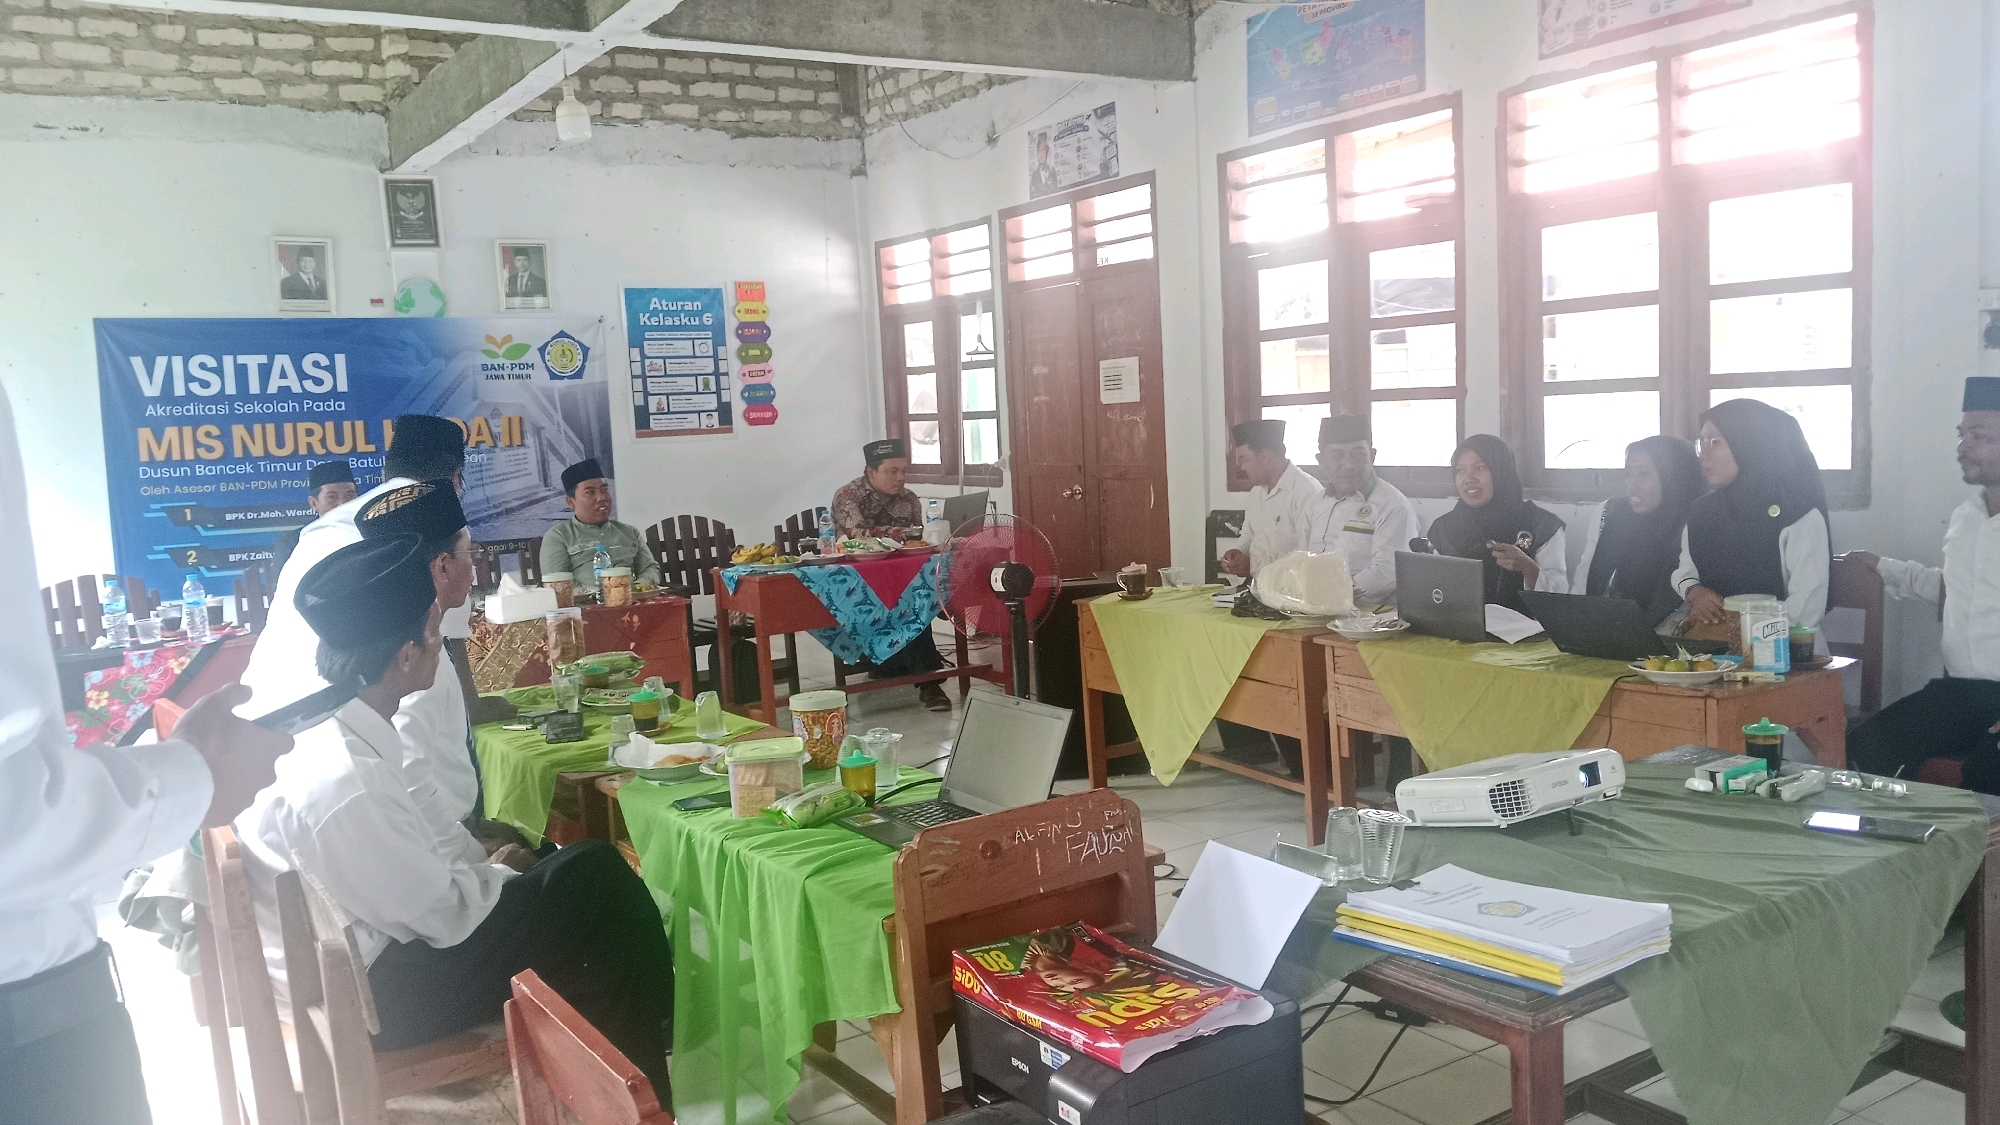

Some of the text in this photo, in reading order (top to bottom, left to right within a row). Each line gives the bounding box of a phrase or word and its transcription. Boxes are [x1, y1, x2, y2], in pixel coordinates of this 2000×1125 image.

[649, 297, 702, 311] Aturan
[639, 312, 713, 326] Kelasku 6
[481, 362, 535, 372] BAN-PDM
[129, 352, 349, 397] VISITASI
[145, 398, 346, 417] Akreditasi Sekolah Pada
[137, 424, 225, 463] MIS
[231, 420, 376, 458] NURUL
[501, 414, 524, 447] II
[139, 466, 191, 479] Dusun
[195, 462, 254, 476] Bancek
[257, 460, 302, 473] Timur
[140, 485, 171, 496] Oleh
[174, 484, 216, 494] Asesor
[220, 480, 278, 492] BAN-PDM
[281, 477, 310, 489] Provi
[365, 474, 383, 484] Tim
[184, 508, 193, 521] 1
[225, 512, 246, 521] BPK
[187, 550, 198, 563] 2
[228, 553, 249, 562] BPK
[1551, 779, 1569, 789] EPSON
[1011, 1056, 1030, 1074] EPSON
